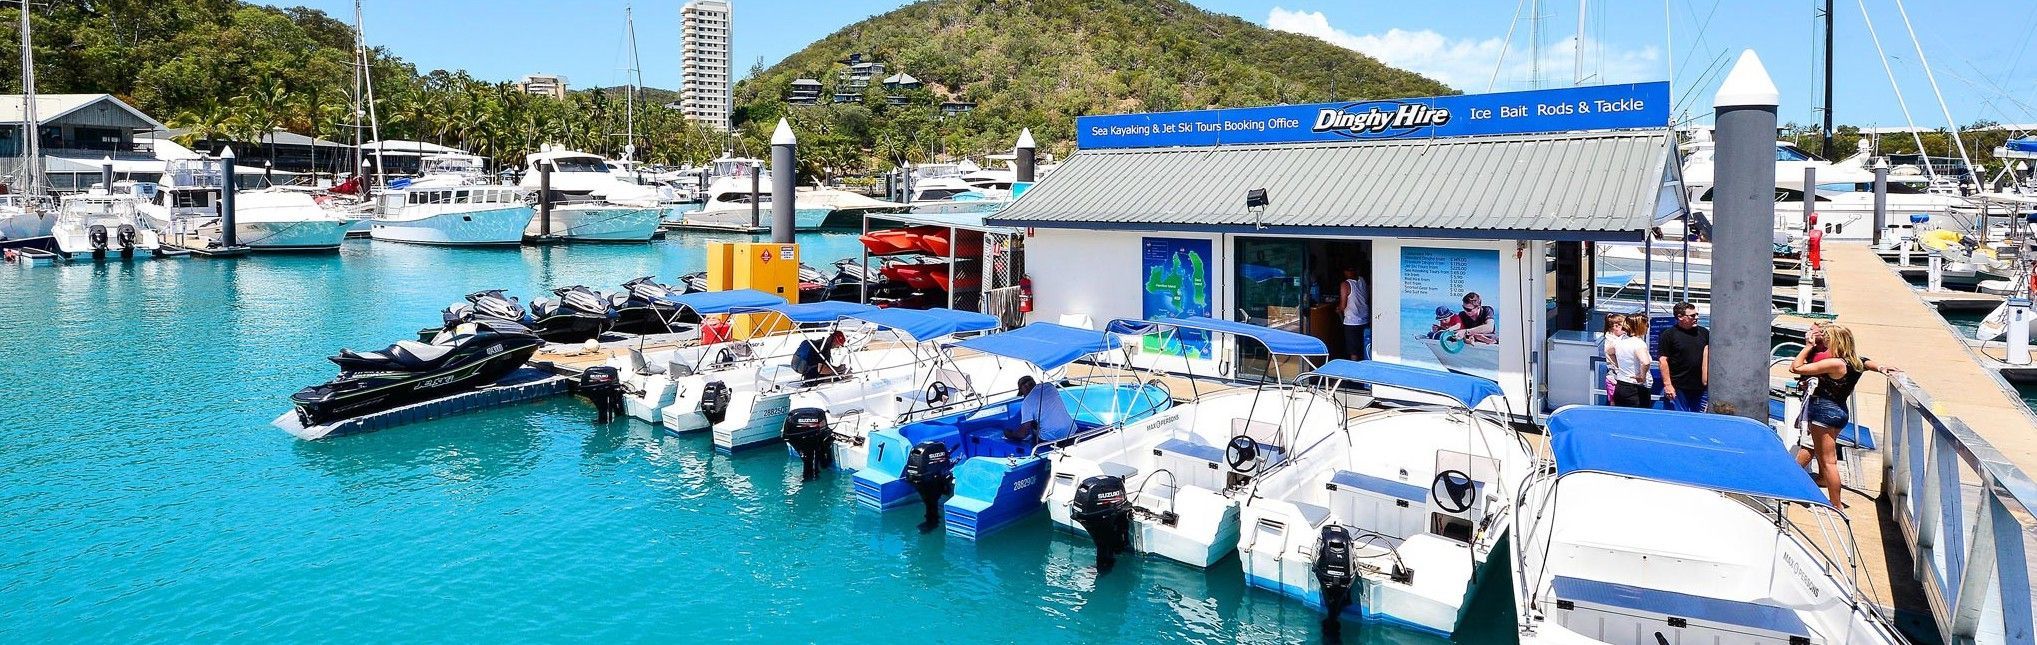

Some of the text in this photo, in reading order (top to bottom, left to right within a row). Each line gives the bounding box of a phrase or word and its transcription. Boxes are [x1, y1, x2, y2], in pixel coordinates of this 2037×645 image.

[1470, 97, 1644, 120] Ice Bait Rods & Tackle
[1092, 117, 1299, 136] Sea Kayaking & Jet Ski Tours Booking Office
[679, 385, 687, 398] 2
[1146, 423, 1157, 431] MAX
[1160, 414, 1180, 426] PERSONS
[877, 441, 886, 463] 1
[928, 451, 946, 459] SUZUKI
[1097, 490, 1120, 499] SUZUKI
[1798, 568, 1820, 598] PERSONS
